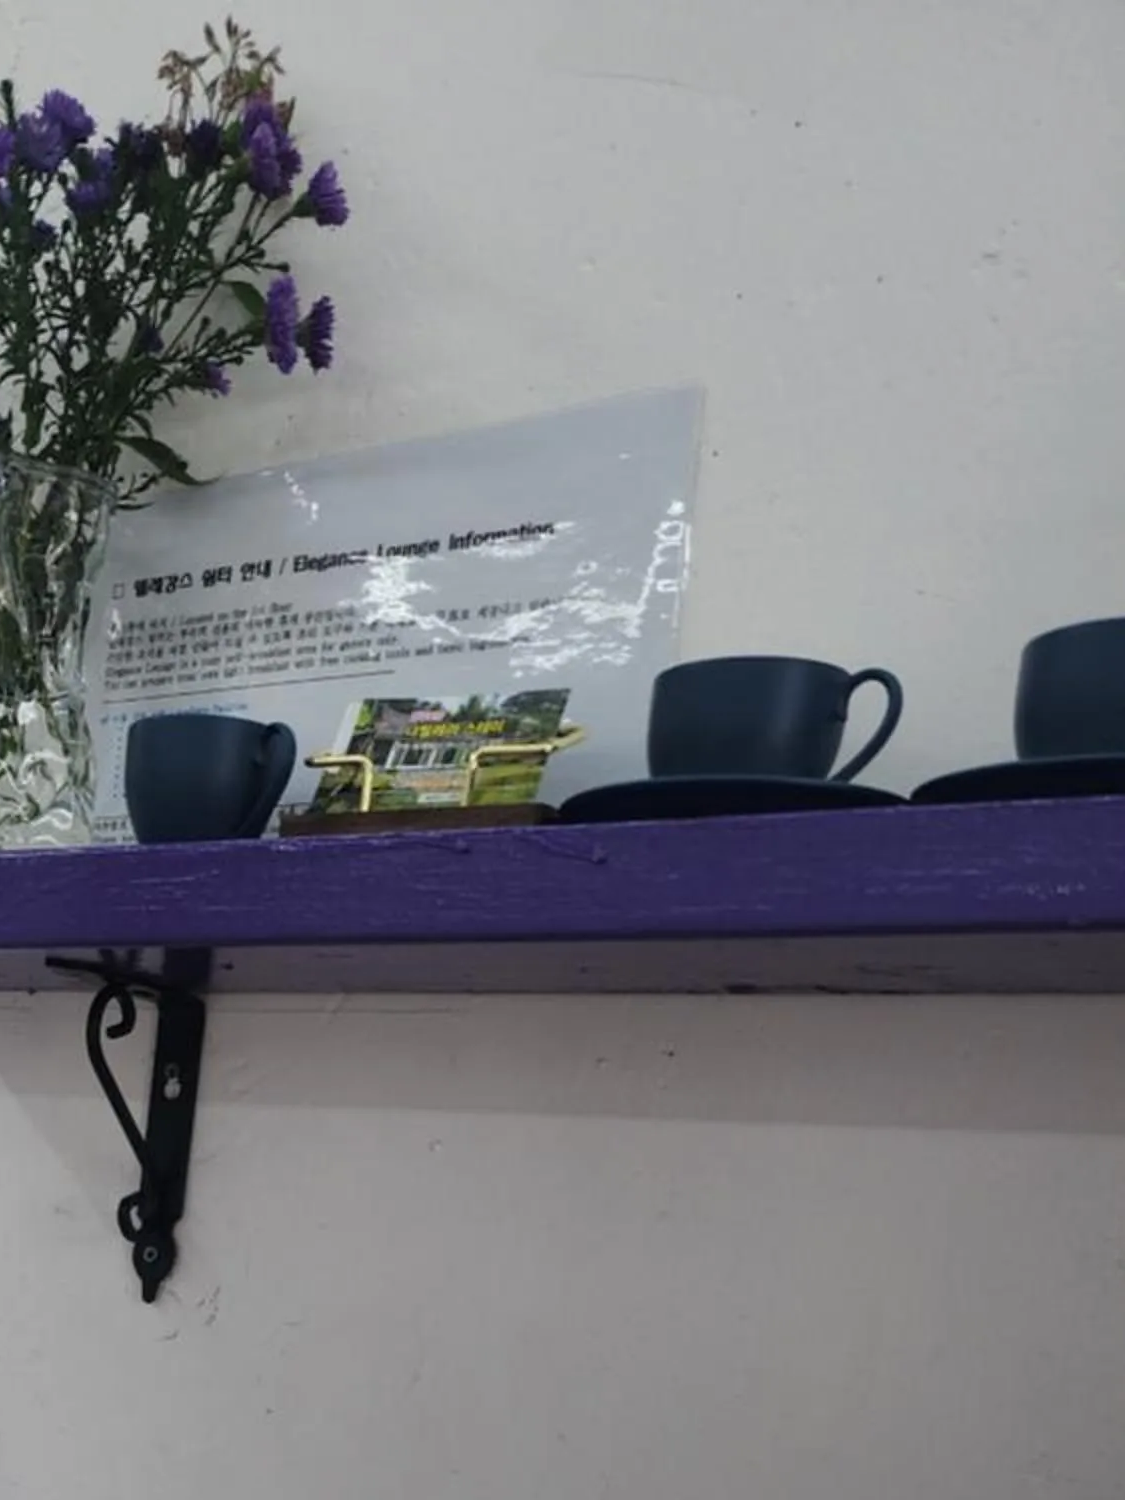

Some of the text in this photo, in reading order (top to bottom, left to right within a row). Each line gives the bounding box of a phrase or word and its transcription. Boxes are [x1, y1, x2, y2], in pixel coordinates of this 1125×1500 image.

[239, 559, 272, 582] 안내
[293, 549, 368, 574] Elegance
[377, 538, 441, 559] Lounge
[448, 522, 556, 551] Information
